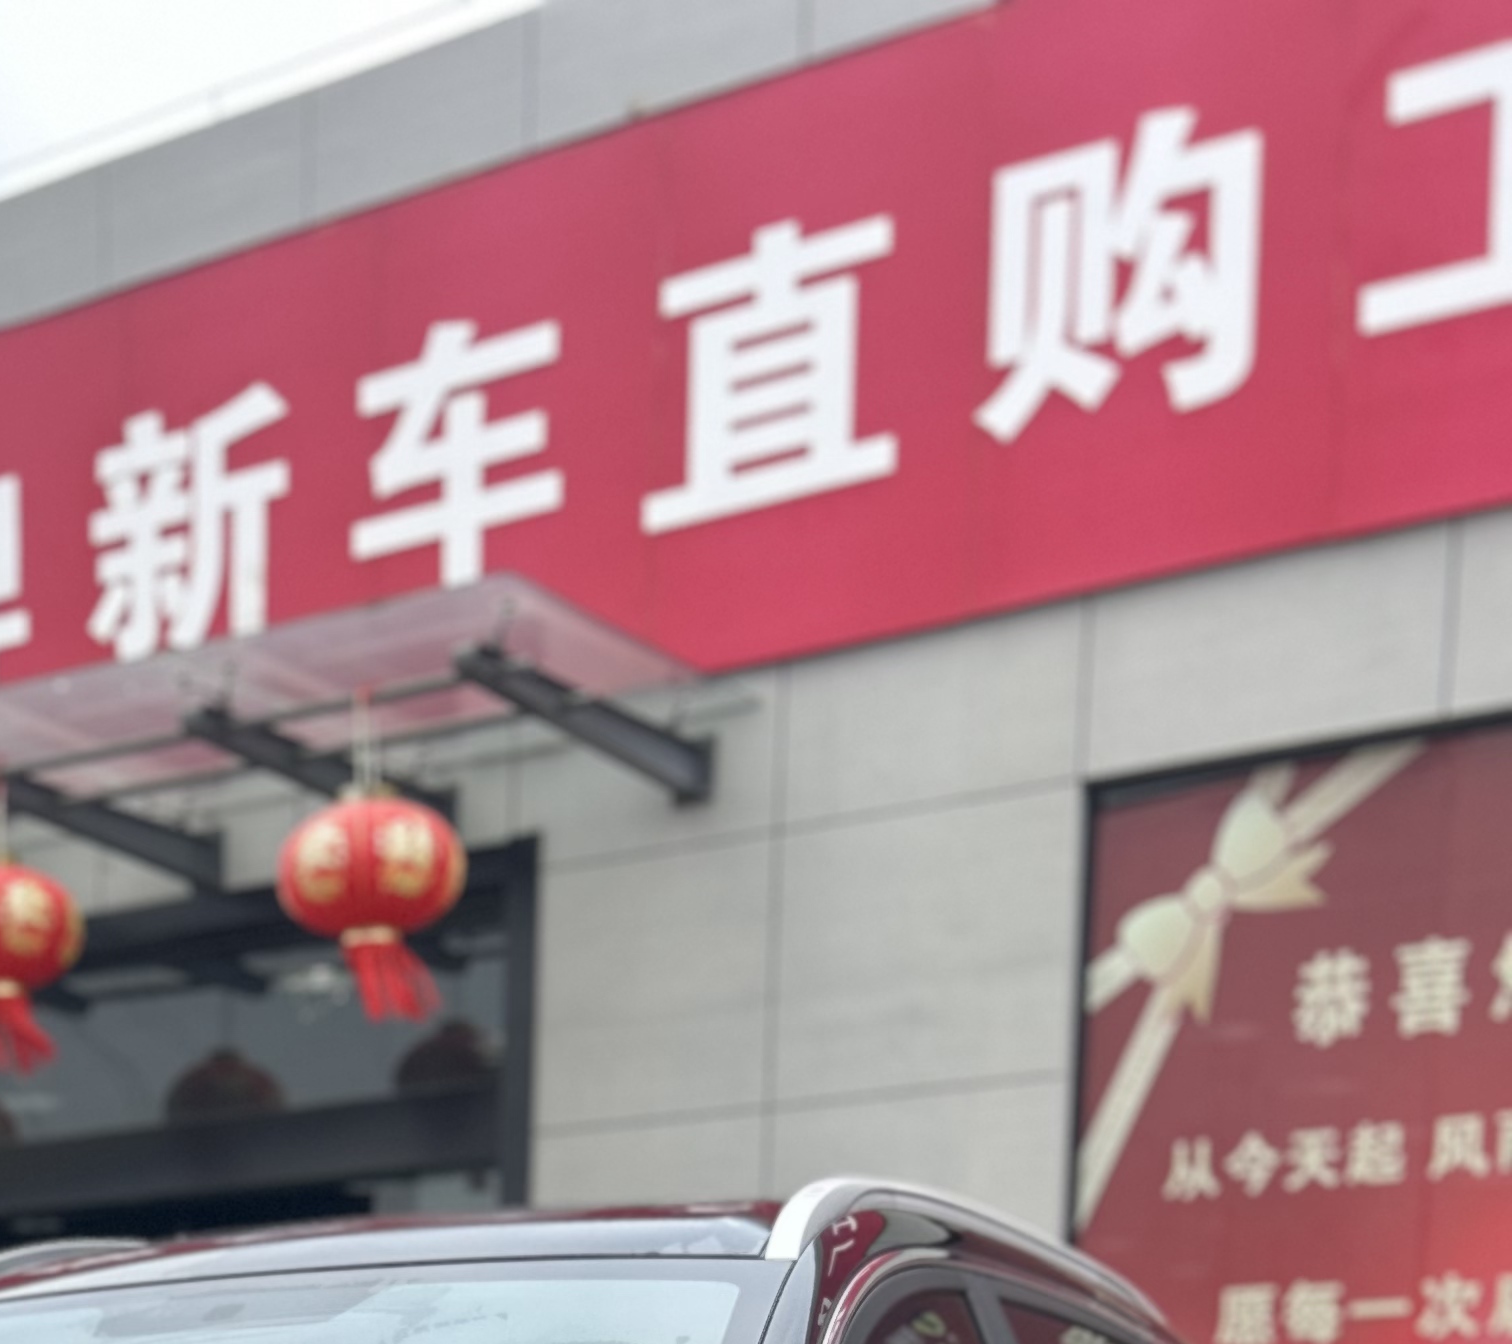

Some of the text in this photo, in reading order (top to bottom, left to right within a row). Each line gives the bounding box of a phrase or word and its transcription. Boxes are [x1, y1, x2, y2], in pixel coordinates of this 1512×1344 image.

[1292, 930, 1512, 1048] 恭喜
[1162, 1108, 1512, 1203] 从今天起 风
